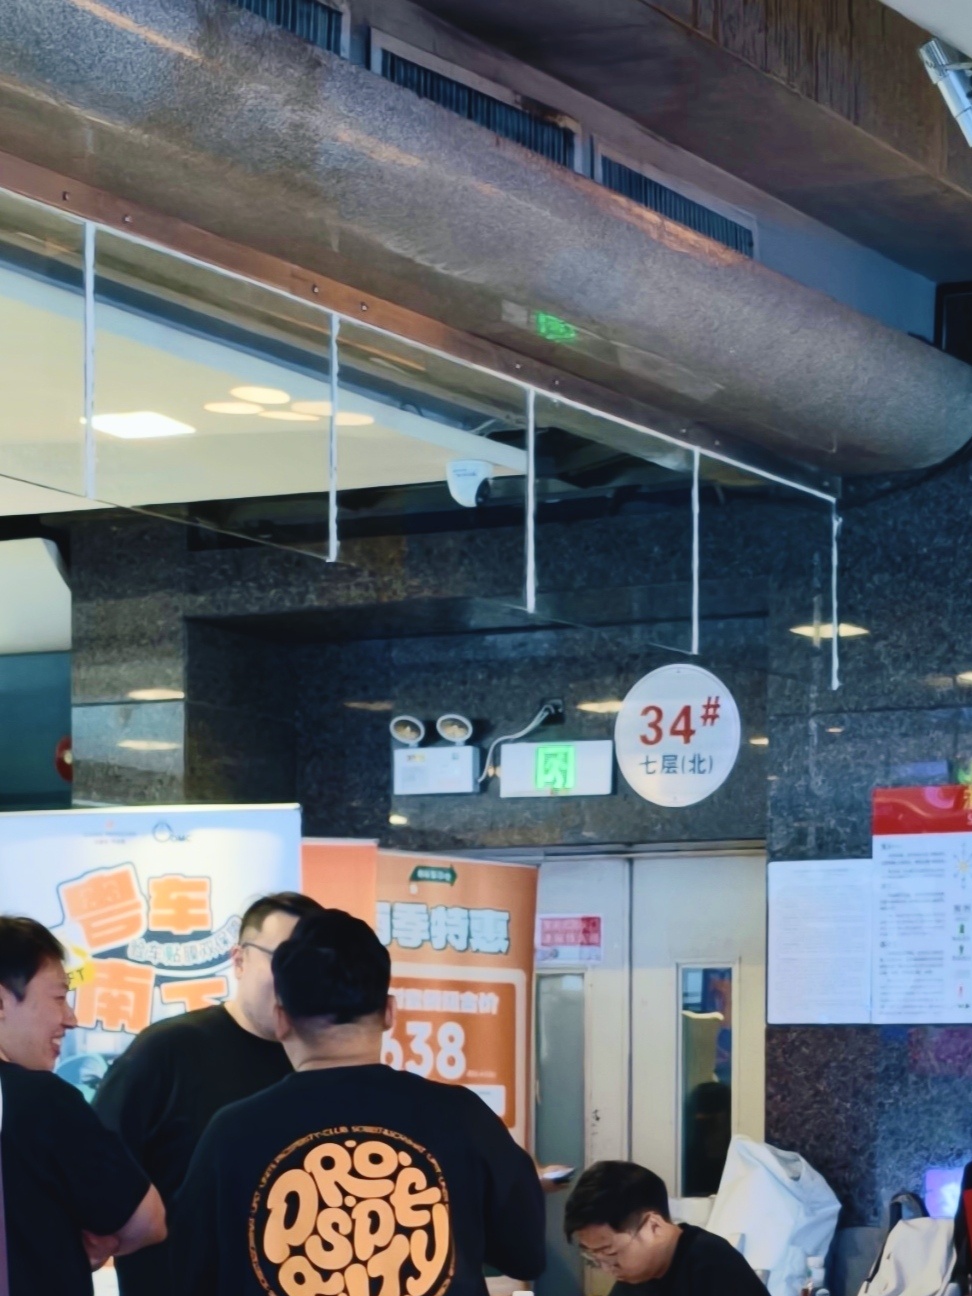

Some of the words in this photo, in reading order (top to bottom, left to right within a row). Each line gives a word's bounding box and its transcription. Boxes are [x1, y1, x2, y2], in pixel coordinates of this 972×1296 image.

[639, 696, 720, 746] 34#
[639, 754, 714, 776] 七层(北)
